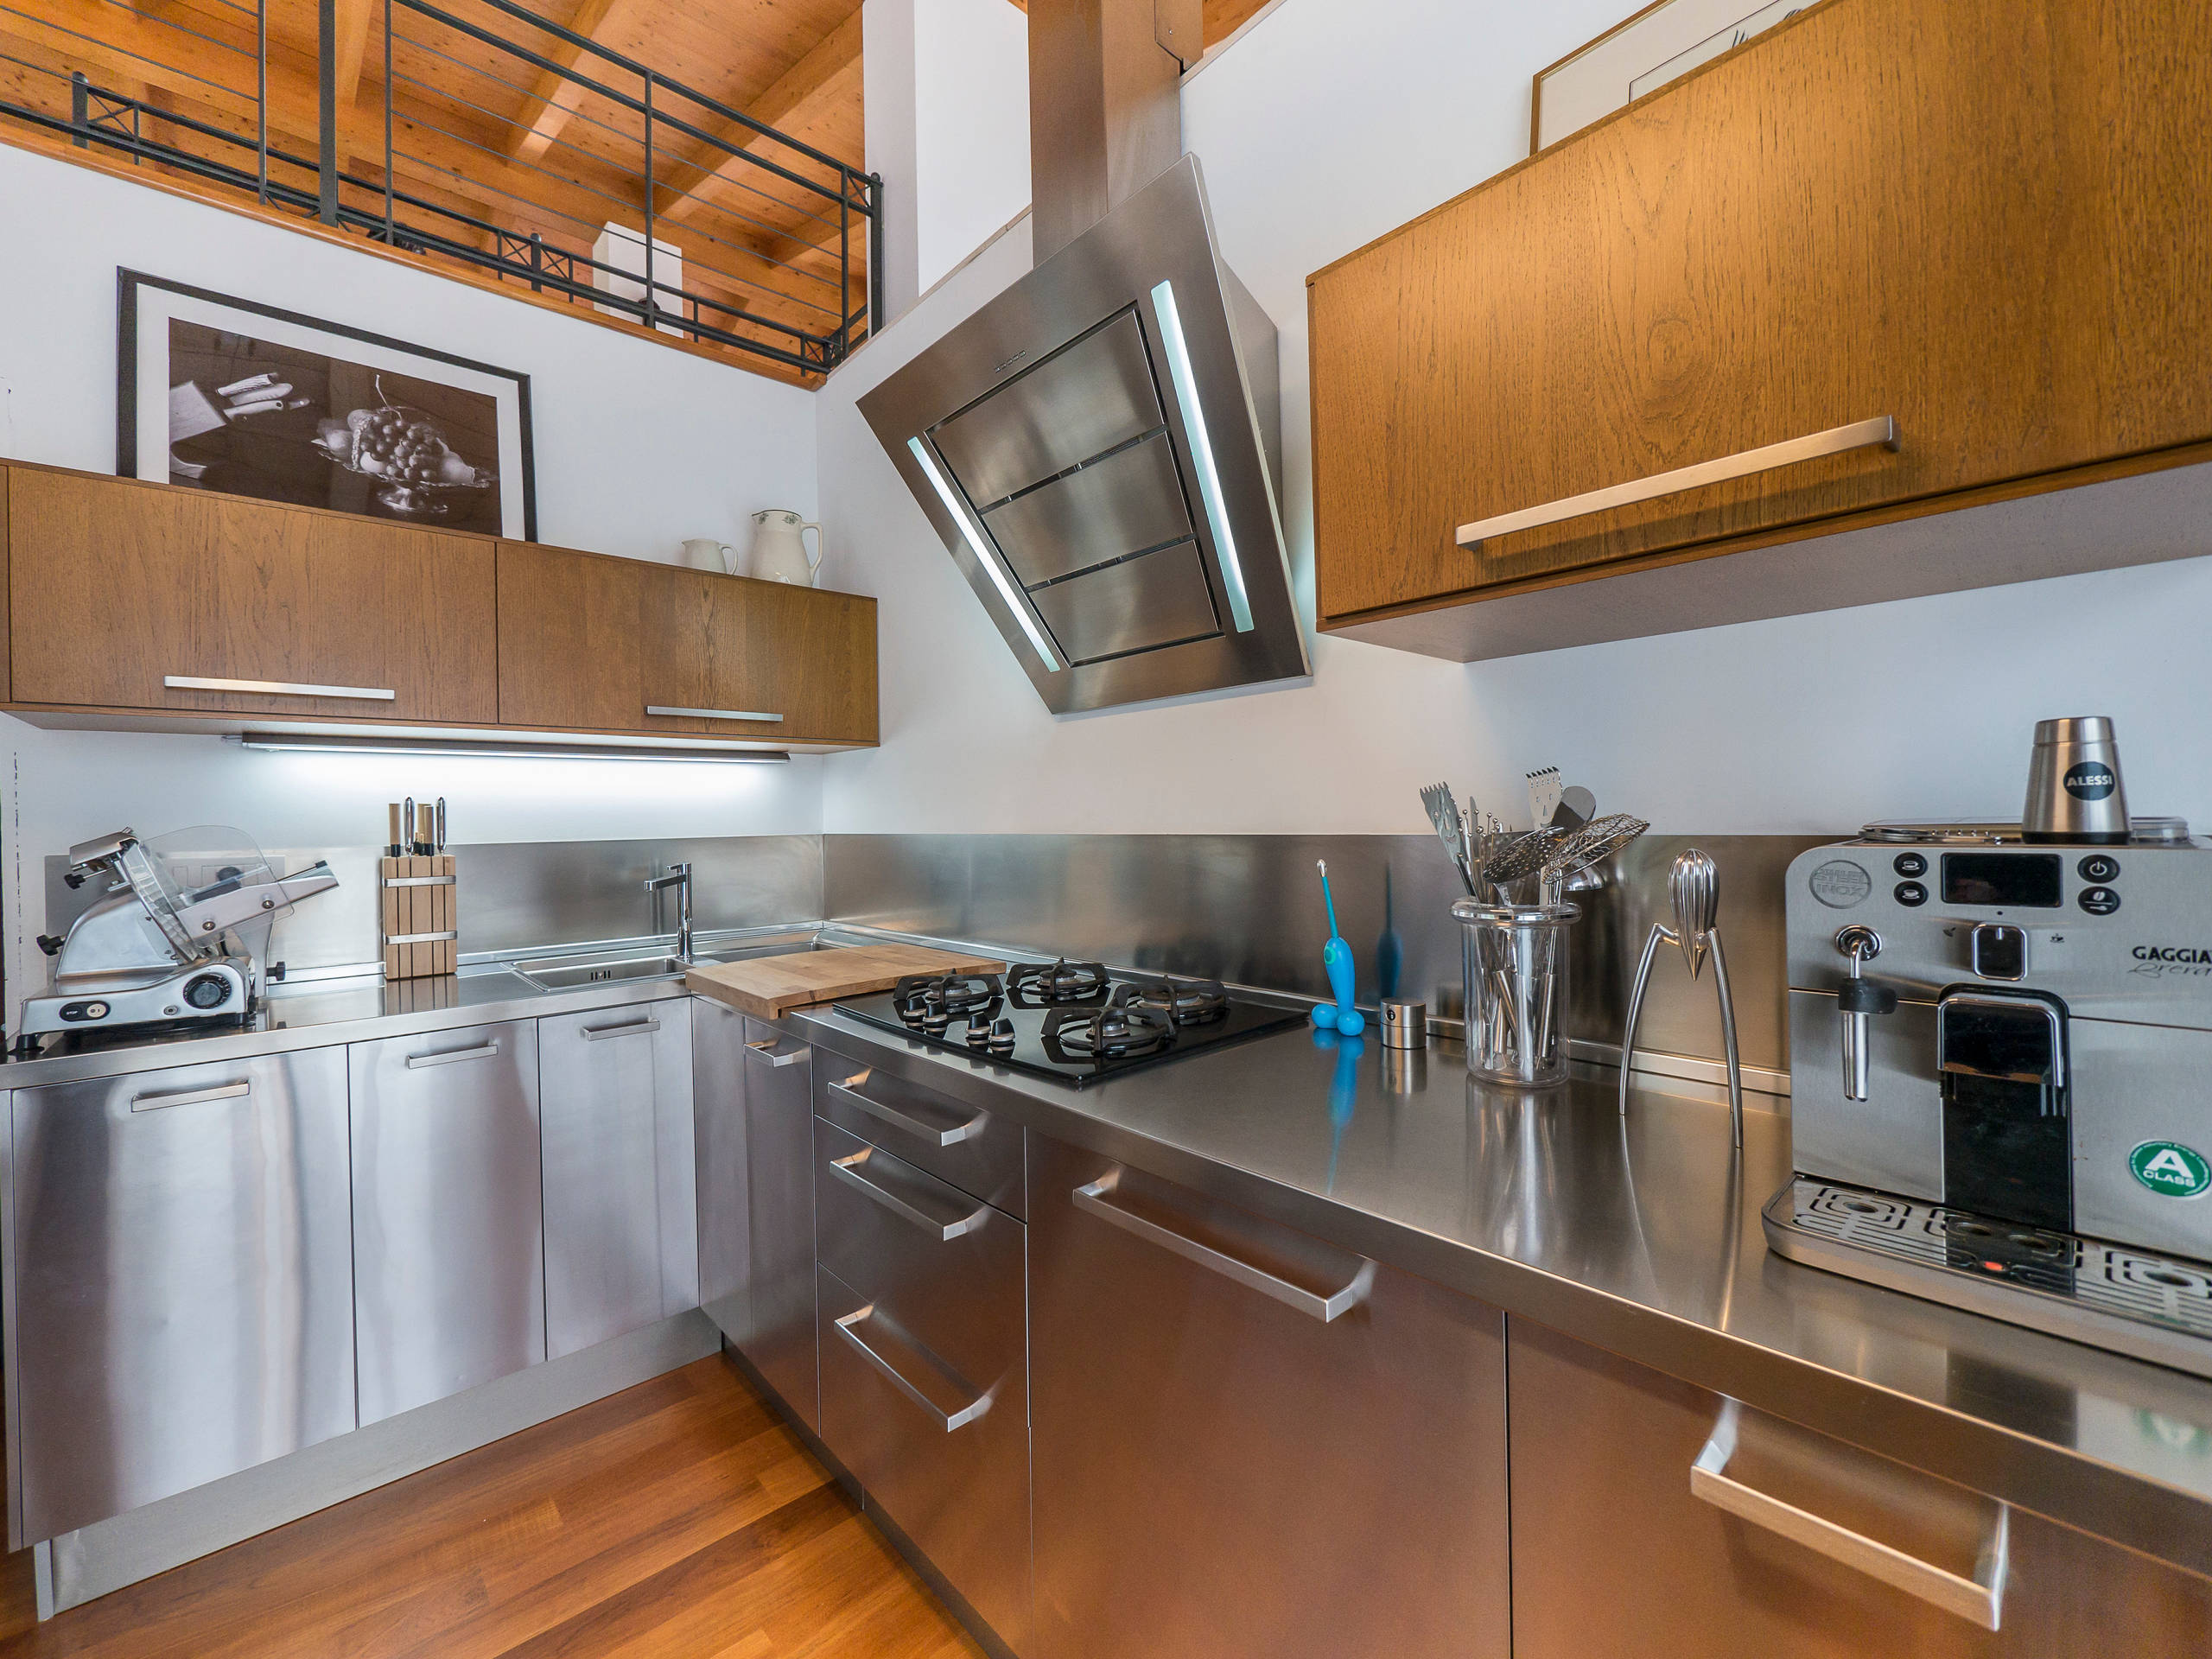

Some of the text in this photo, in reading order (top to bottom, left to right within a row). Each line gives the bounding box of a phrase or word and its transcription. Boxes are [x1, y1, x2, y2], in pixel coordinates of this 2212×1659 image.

[2066, 775, 2113, 786] ALESSI
[2132, 946, 2212, 964] GAGGIA
[2145, 1148, 2194, 1178] A
[2143, 1170, 2196, 1187] CLASS
